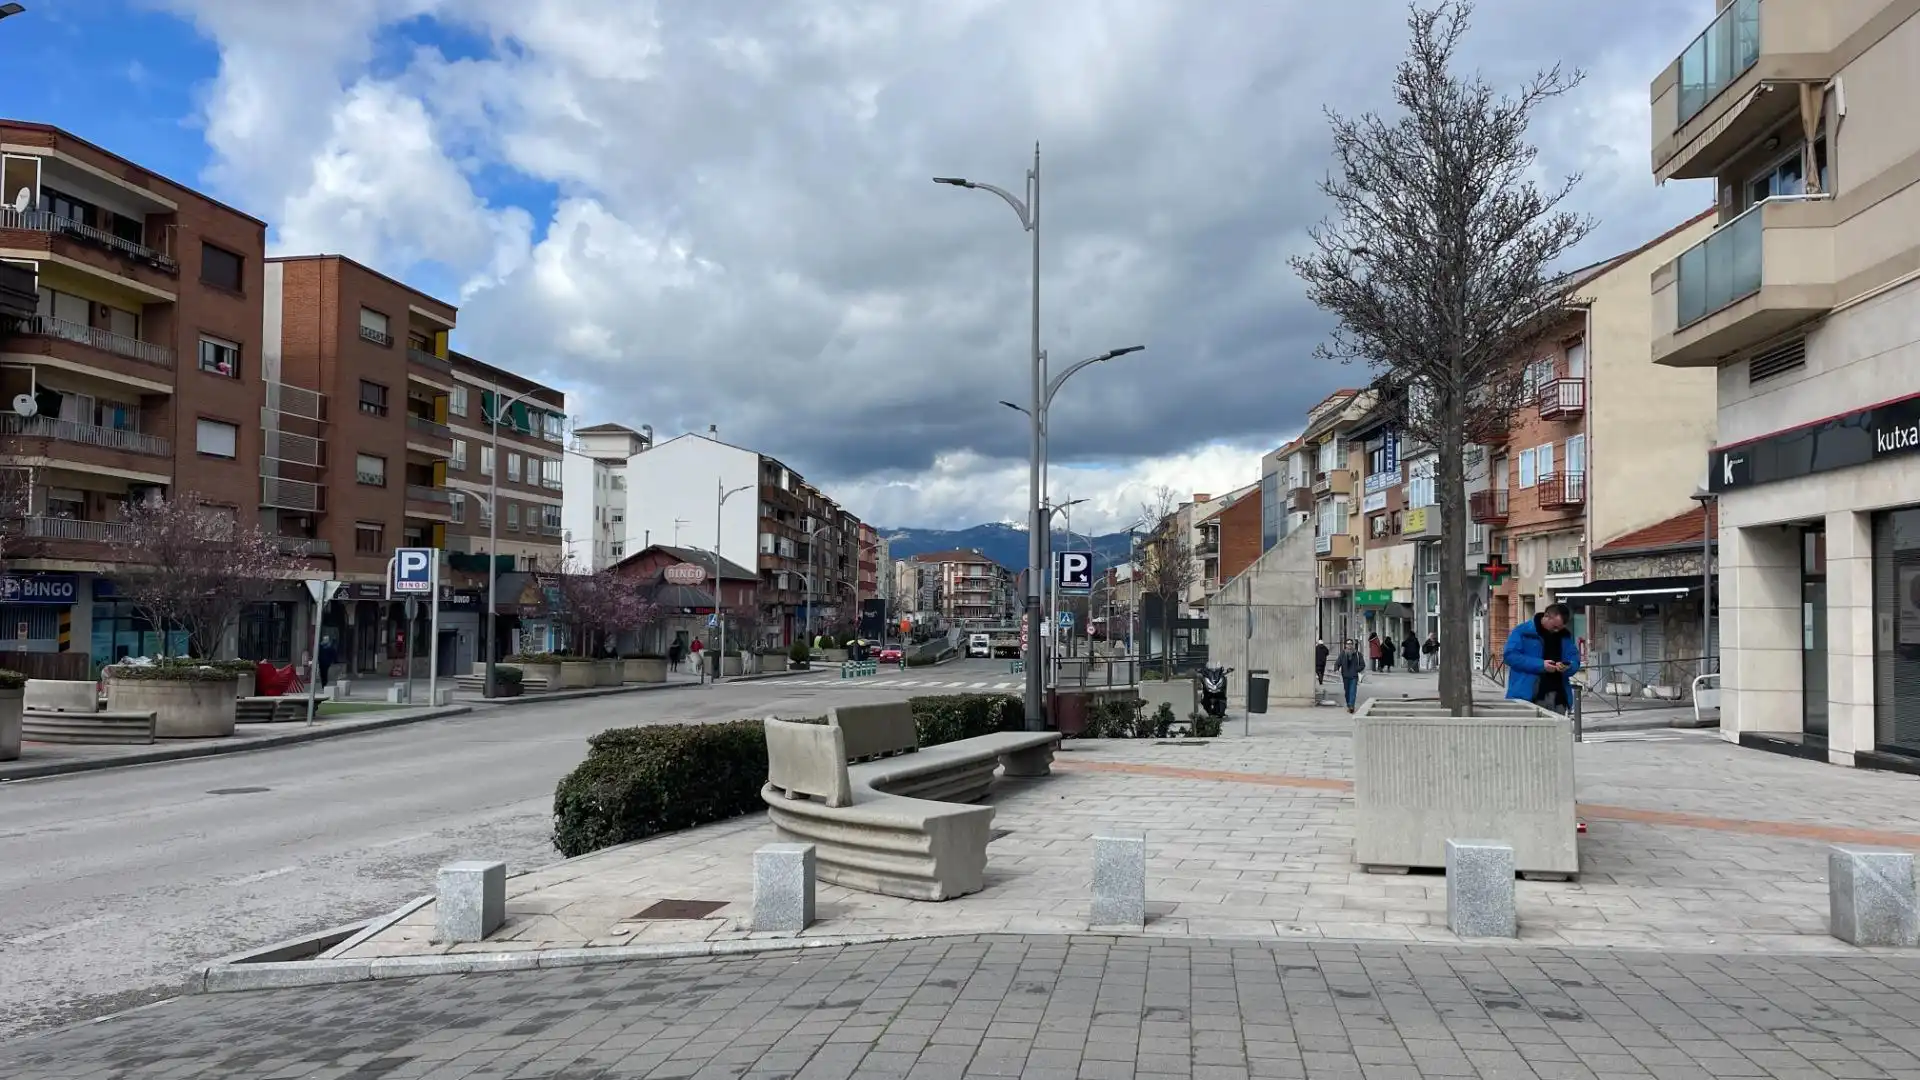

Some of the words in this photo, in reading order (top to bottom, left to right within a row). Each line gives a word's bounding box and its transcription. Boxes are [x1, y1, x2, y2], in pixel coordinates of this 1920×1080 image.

[1878, 418, 1920, 452] kutxa
[401, 552, 427, 578] P
[667, 568, 702, 578] BINGO
[1063, 554, 1088, 582] P
[24, 581, 73, 596] BINGO
